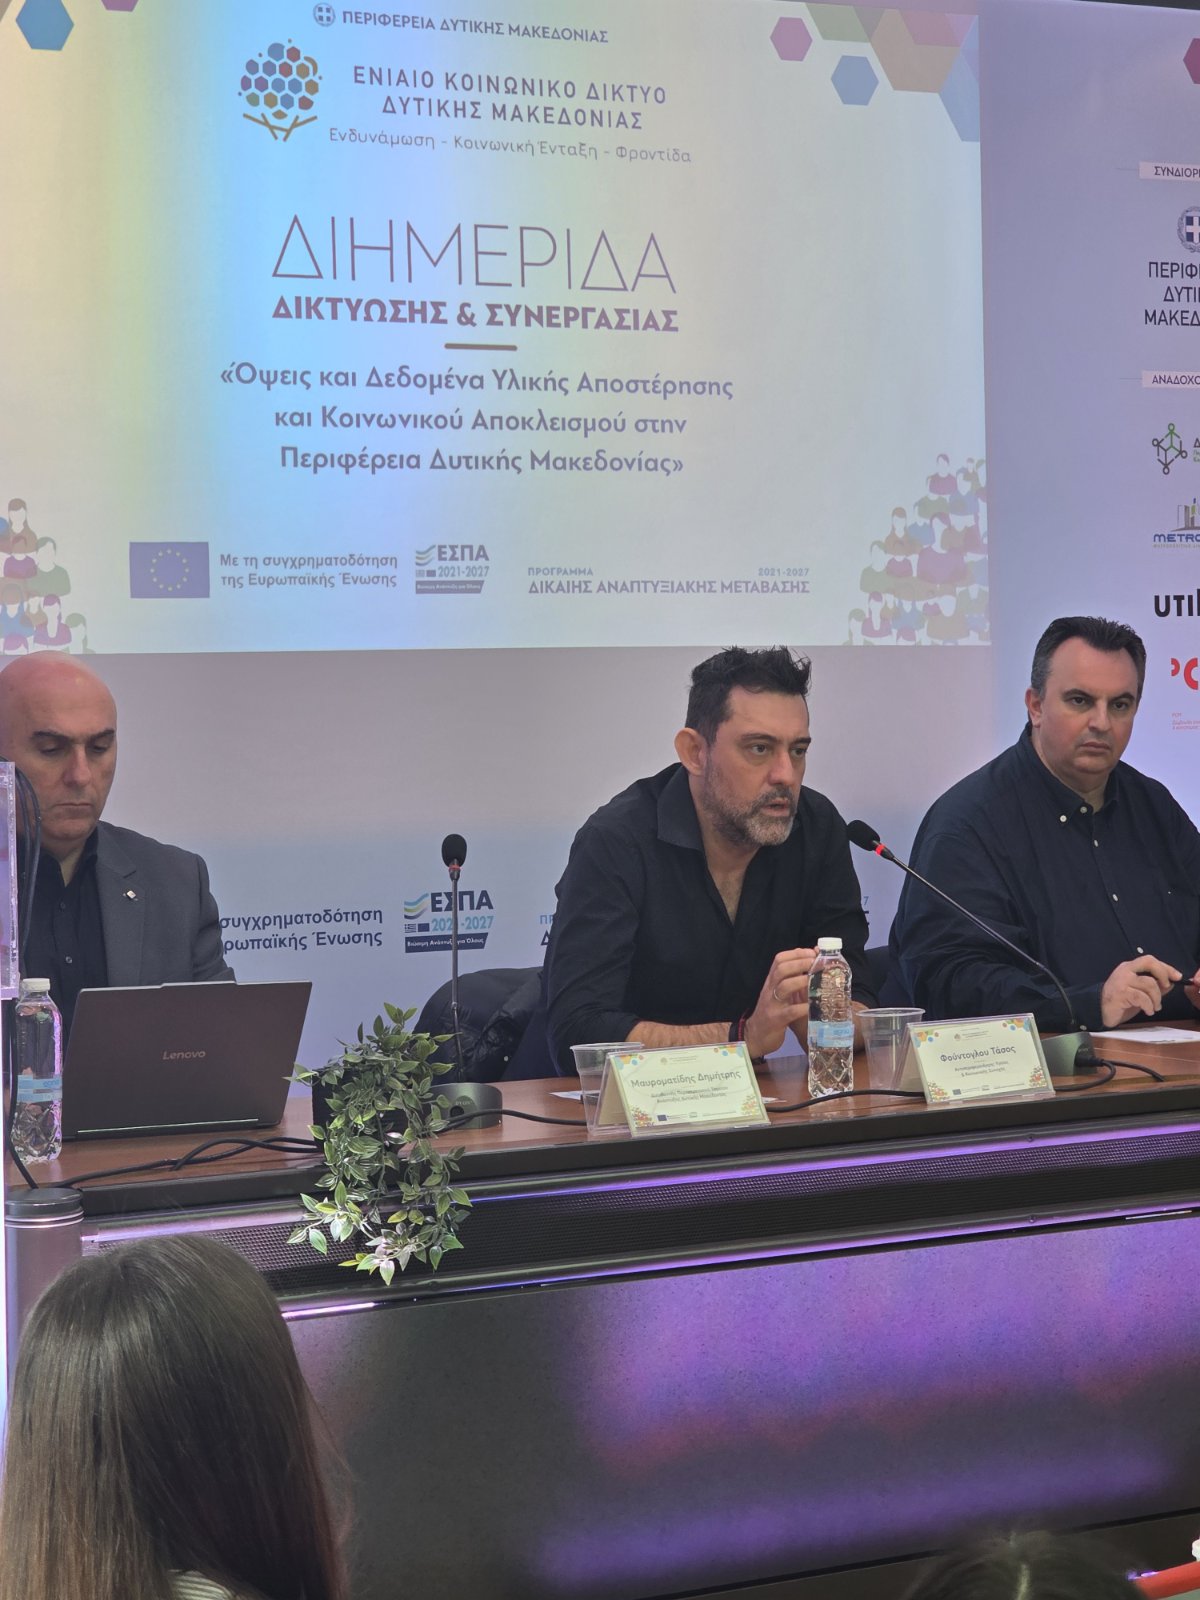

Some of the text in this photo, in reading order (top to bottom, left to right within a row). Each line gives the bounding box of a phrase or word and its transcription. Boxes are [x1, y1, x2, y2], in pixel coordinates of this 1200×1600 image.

[342, 10, 609, 43] ΠΕΡΙΦΕΡΕΙΑ ΔΥΤΙΚΗΣ ΜΑΚΕΔΟΝΙΑΣ
[353, 65, 667, 104] ΕΝΙΑΙΟ ΚΟΙΝΩΝΙΚΟ ΔΙΚΤΥΟ
[382, 95, 643, 129] ΔΥΤΙΚΗΣ ΜΑΚΕΔΟΝΙΑΣ
[329, 127, 435, 149] Ενδυνάμωση
[454, 135, 535, 156] Κοινωνική
[537, 140, 598, 160] Ένταξη
[616, 145, 692, 163] Φροντίδα
[1154, 165, 1200, 178] ΣΥΝΔΙΟΡ
[271, 213, 677, 294] ΔΙΗΜΕΡΙΔΑ
[1149, 261, 1200, 279] ΠΕΡΙΦ
[1163, 286, 1200, 303] ΔΥΤΙ
[271, 295, 679, 333] ΔΙΚΤΥΩΣΗΣ & ΣΥΝΕΡΓΑΣΙΑΣ
[220, 361, 733, 400] «Όψεις και Δεδομένα Υλικής Αποστέρησης
[275, 405, 687, 438] και Κοινωνικού Αποκλεισμού στην
[280, 445, 684, 476] Περιφέρεια Δυτικής Μακεδονίας»
[220, 553, 398, 570] Με τη συγχρηματοδότηση
[437, 544, 490, 562] ΕΣΠΑ
[221, 572, 397, 588] της Ευρωπαϊκής Ένωσης
[438, 565, 490, 578] 2021-2027
[527, 567, 593, 577] ΠΡΟΓΡΑΜΜΑ
[757, 567, 810, 577] 2021-2027
[528, 580, 810, 594] ΔΙΚΑΙΗΣ ΑΝΑΠΤΥΞΙΑΚΗΣ ΜΕΤΑΒΑΣΗΣ
[219, 908, 383, 931] συγχρηματοδότηση
[432, 915, 494, 932] 202-2027
[224, 931, 383, 954] ρωπαϊκής Ένωσης
[162, 1050, 206, 1061] Lenovo
[990, 1045, 1017, 1055] Τάσος
[698, 1070, 741, 1083] Δημήτρης
